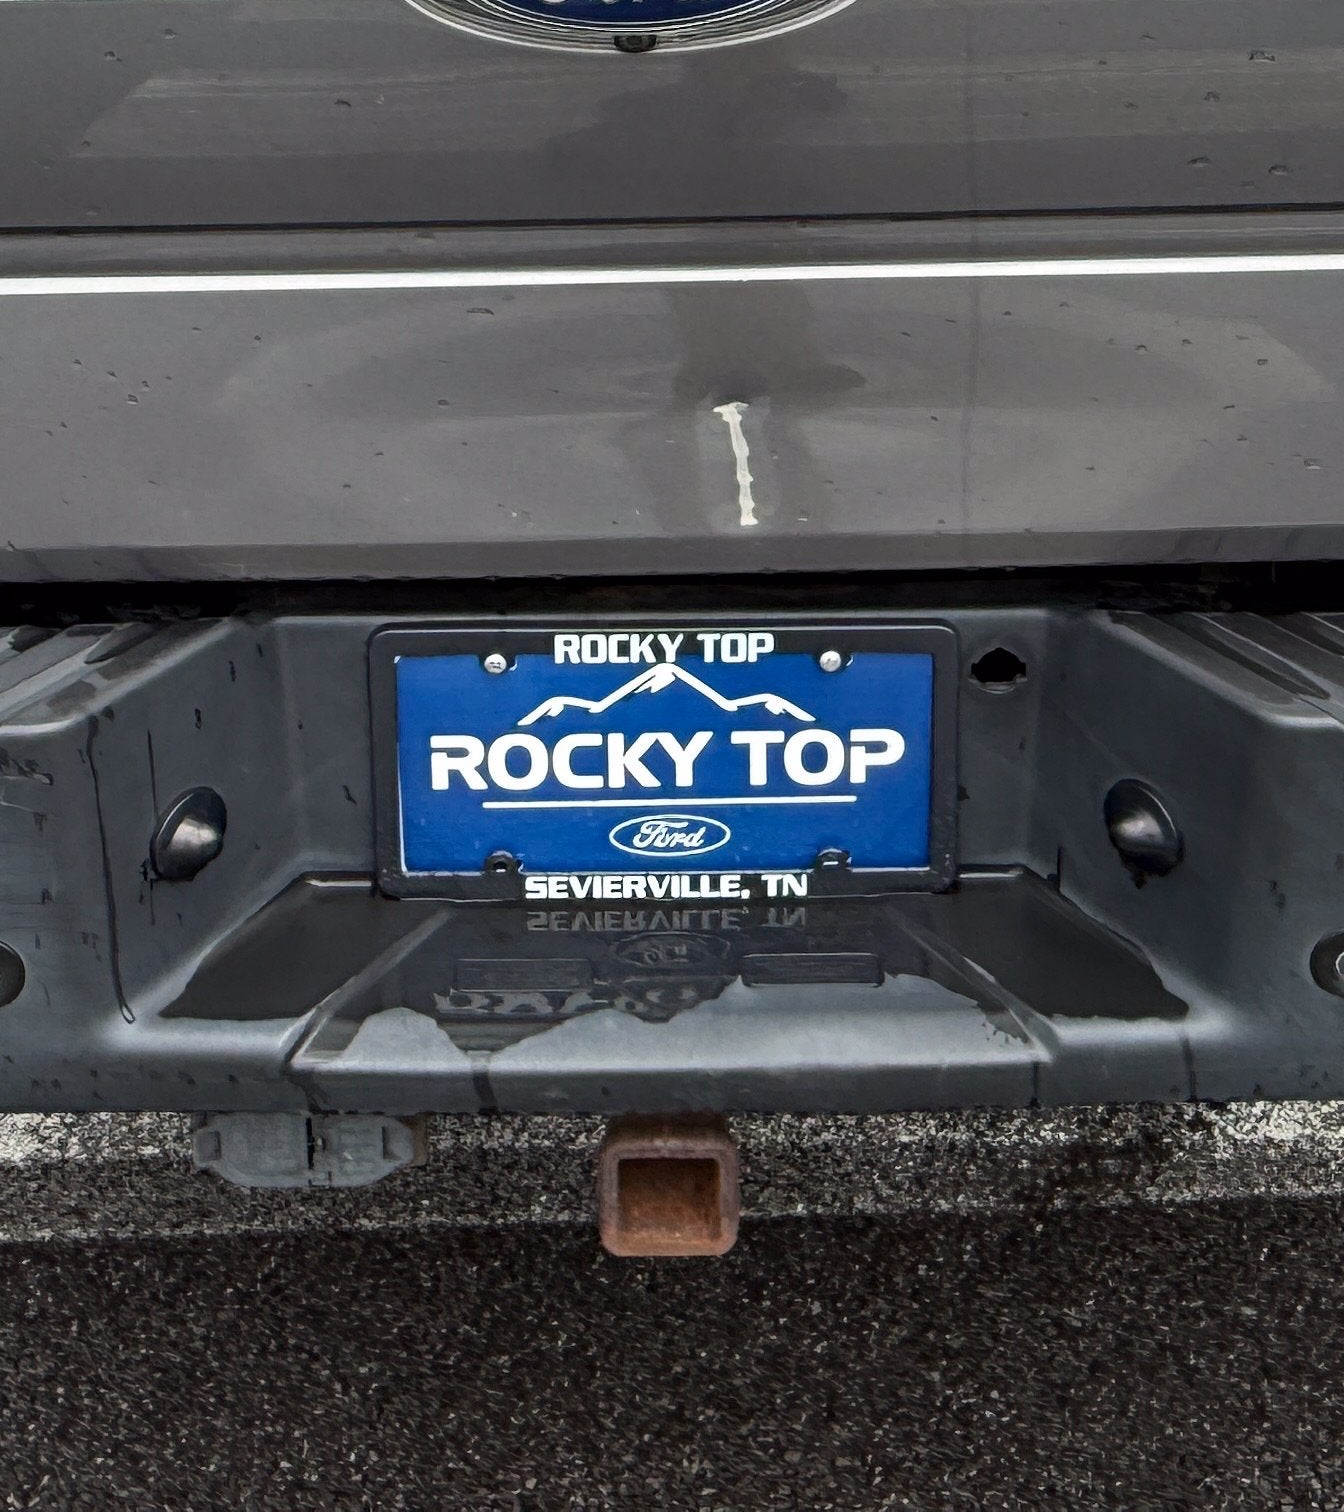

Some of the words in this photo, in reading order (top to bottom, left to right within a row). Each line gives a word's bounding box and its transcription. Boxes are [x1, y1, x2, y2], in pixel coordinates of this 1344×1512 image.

[554, 633, 684, 664] ROCKY
[696, 632, 775, 663] TOP
[430, 730, 714, 791] ROCKY
[731, 728, 906, 786] TOP
[632, 819, 705, 850] Ford
[524, 874, 750, 900] SEVIERVILLE,
[761, 873, 808, 898] TN
